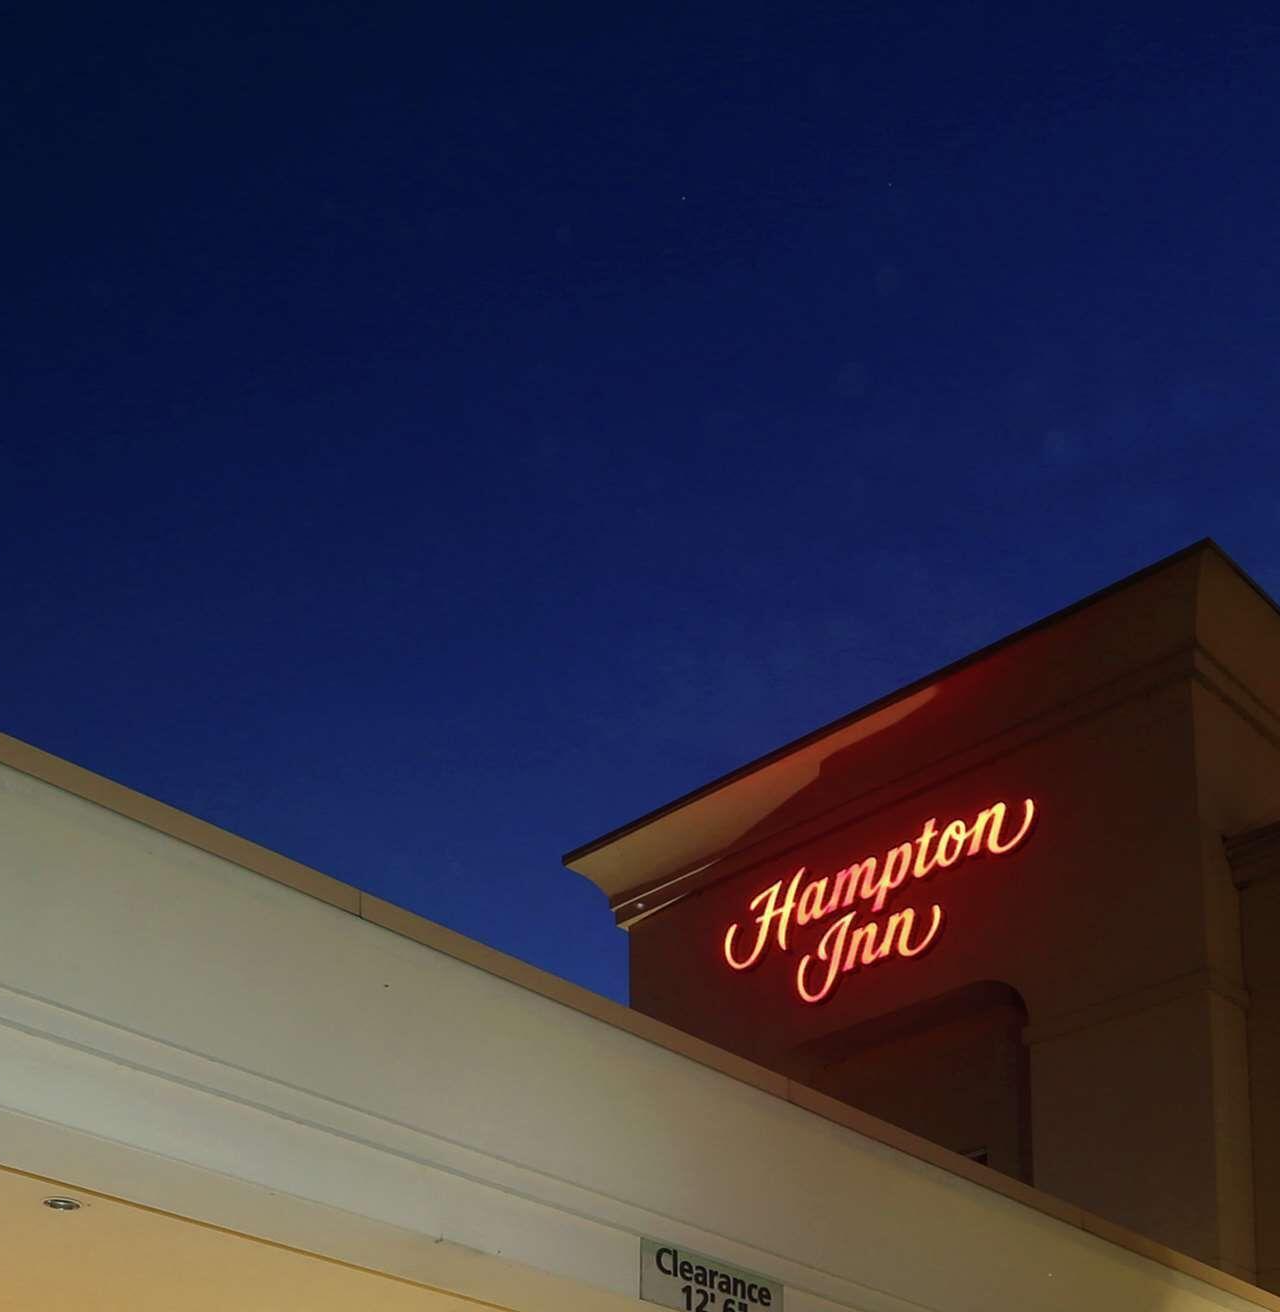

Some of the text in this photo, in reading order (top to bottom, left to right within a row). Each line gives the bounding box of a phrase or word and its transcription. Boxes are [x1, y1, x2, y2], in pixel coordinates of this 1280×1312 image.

[724, 798, 1034, 969] Hampton
[797, 904, 941, 1002] Inn
[656, 1248, 772, 1306] Clearance
